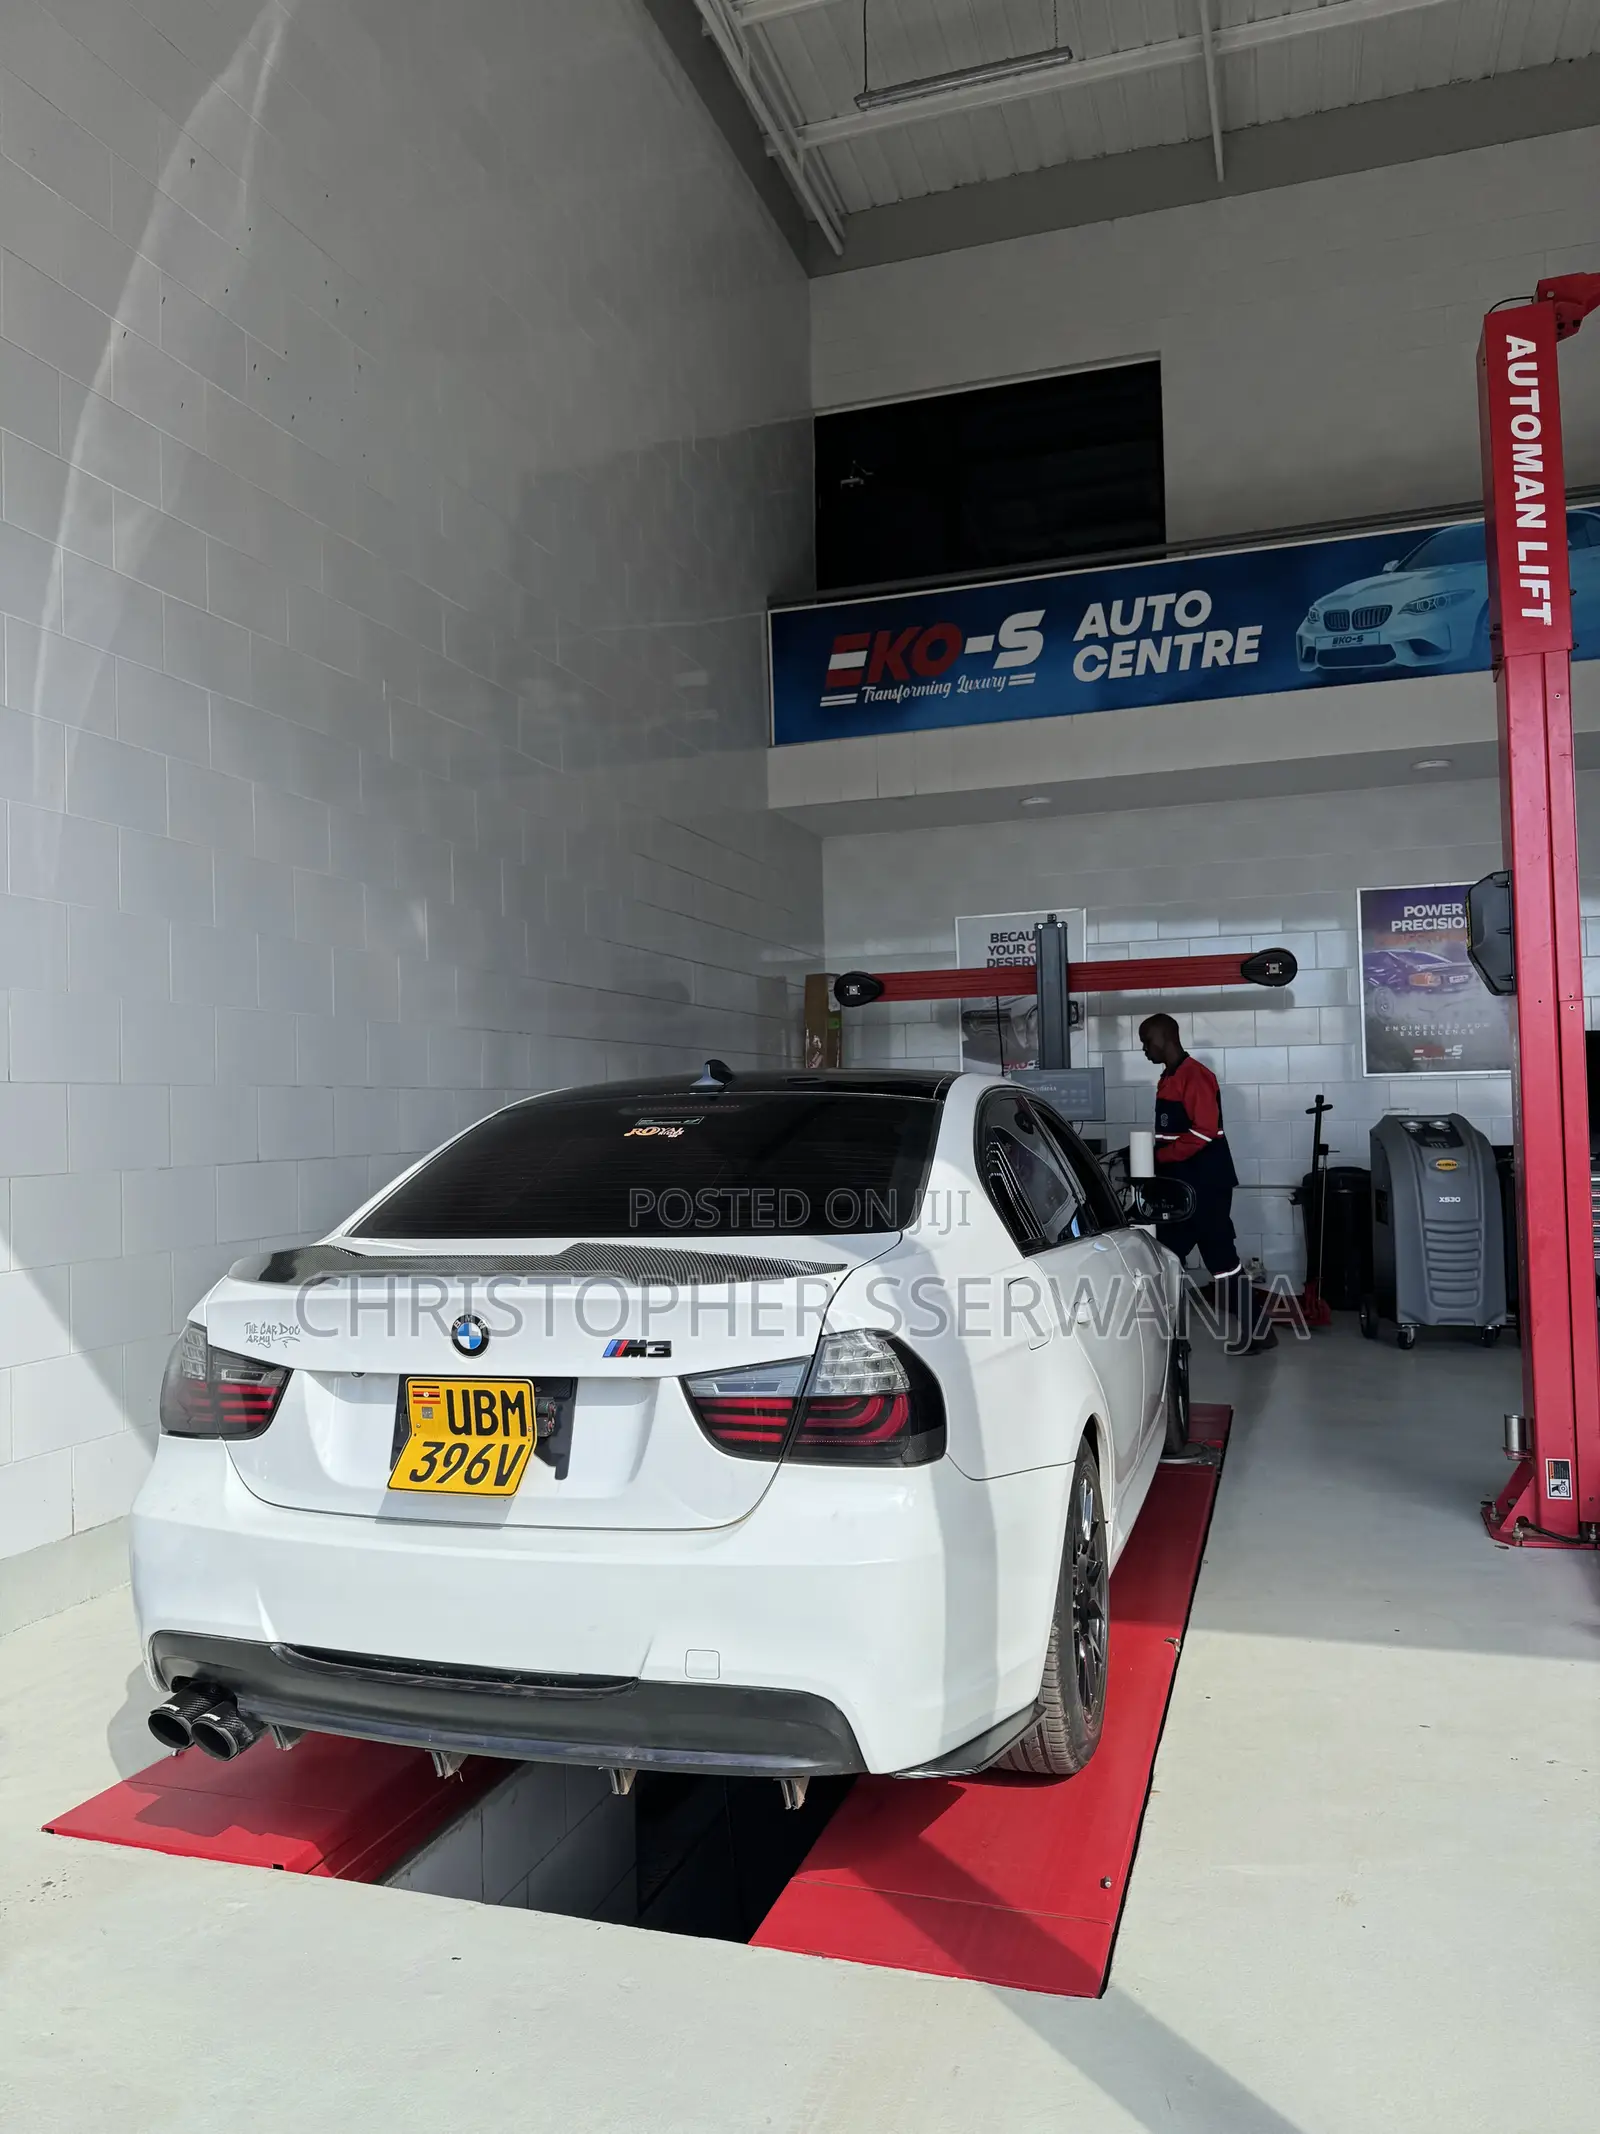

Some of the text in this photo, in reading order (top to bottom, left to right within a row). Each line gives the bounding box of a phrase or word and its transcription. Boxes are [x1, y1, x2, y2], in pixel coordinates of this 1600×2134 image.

[1505, 334, 1552, 625] AUTOMAN LIFT
[1073, 590, 1212, 642] AUTO
[825, 609, 1046, 689] EKO-S
[1073, 625, 1263, 682] CENTRE
[861, 674, 1006, 704] Transforming Luxury
[1403, 903, 1464, 917] POWER
[990, 930, 1036, 944] BECAU
[1391, 917, 1468, 933] PRECISIO
[988, 943, 1026, 956] YOUR
[986, 957, 1038, 968] DESERV
[453, 1314, 487, 1331] BMW
[617, 1339, 672, 1358] M3
[446, 1389, 527, 1437] UBM
[409, 1441, 526, 1487] 396V
